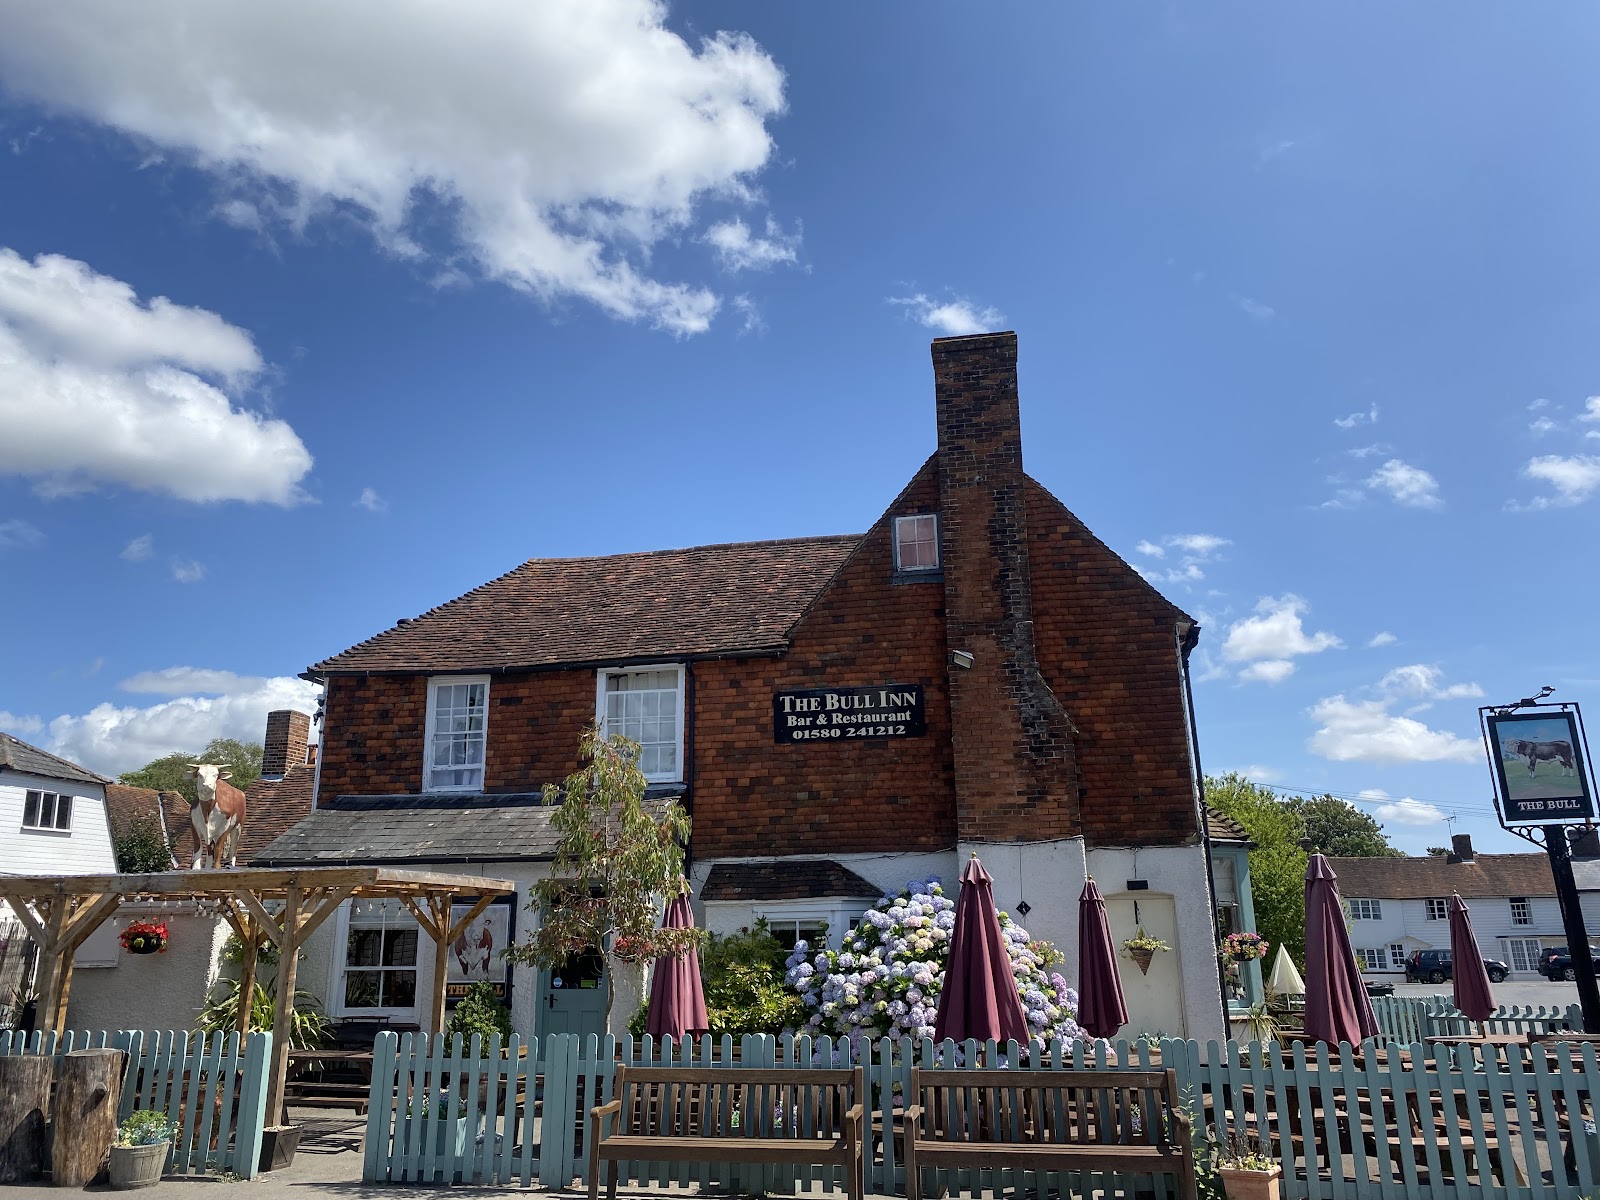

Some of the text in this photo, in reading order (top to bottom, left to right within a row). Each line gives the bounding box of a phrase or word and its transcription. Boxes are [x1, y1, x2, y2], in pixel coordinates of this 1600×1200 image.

[780, 690, 916, 712] THE BULL INN
[787, 710, 911, 727] Bar & Restaurant
[792, 725, 906, 740] 01580 241212
[1517, 799, 1580, 811] THE BULL
